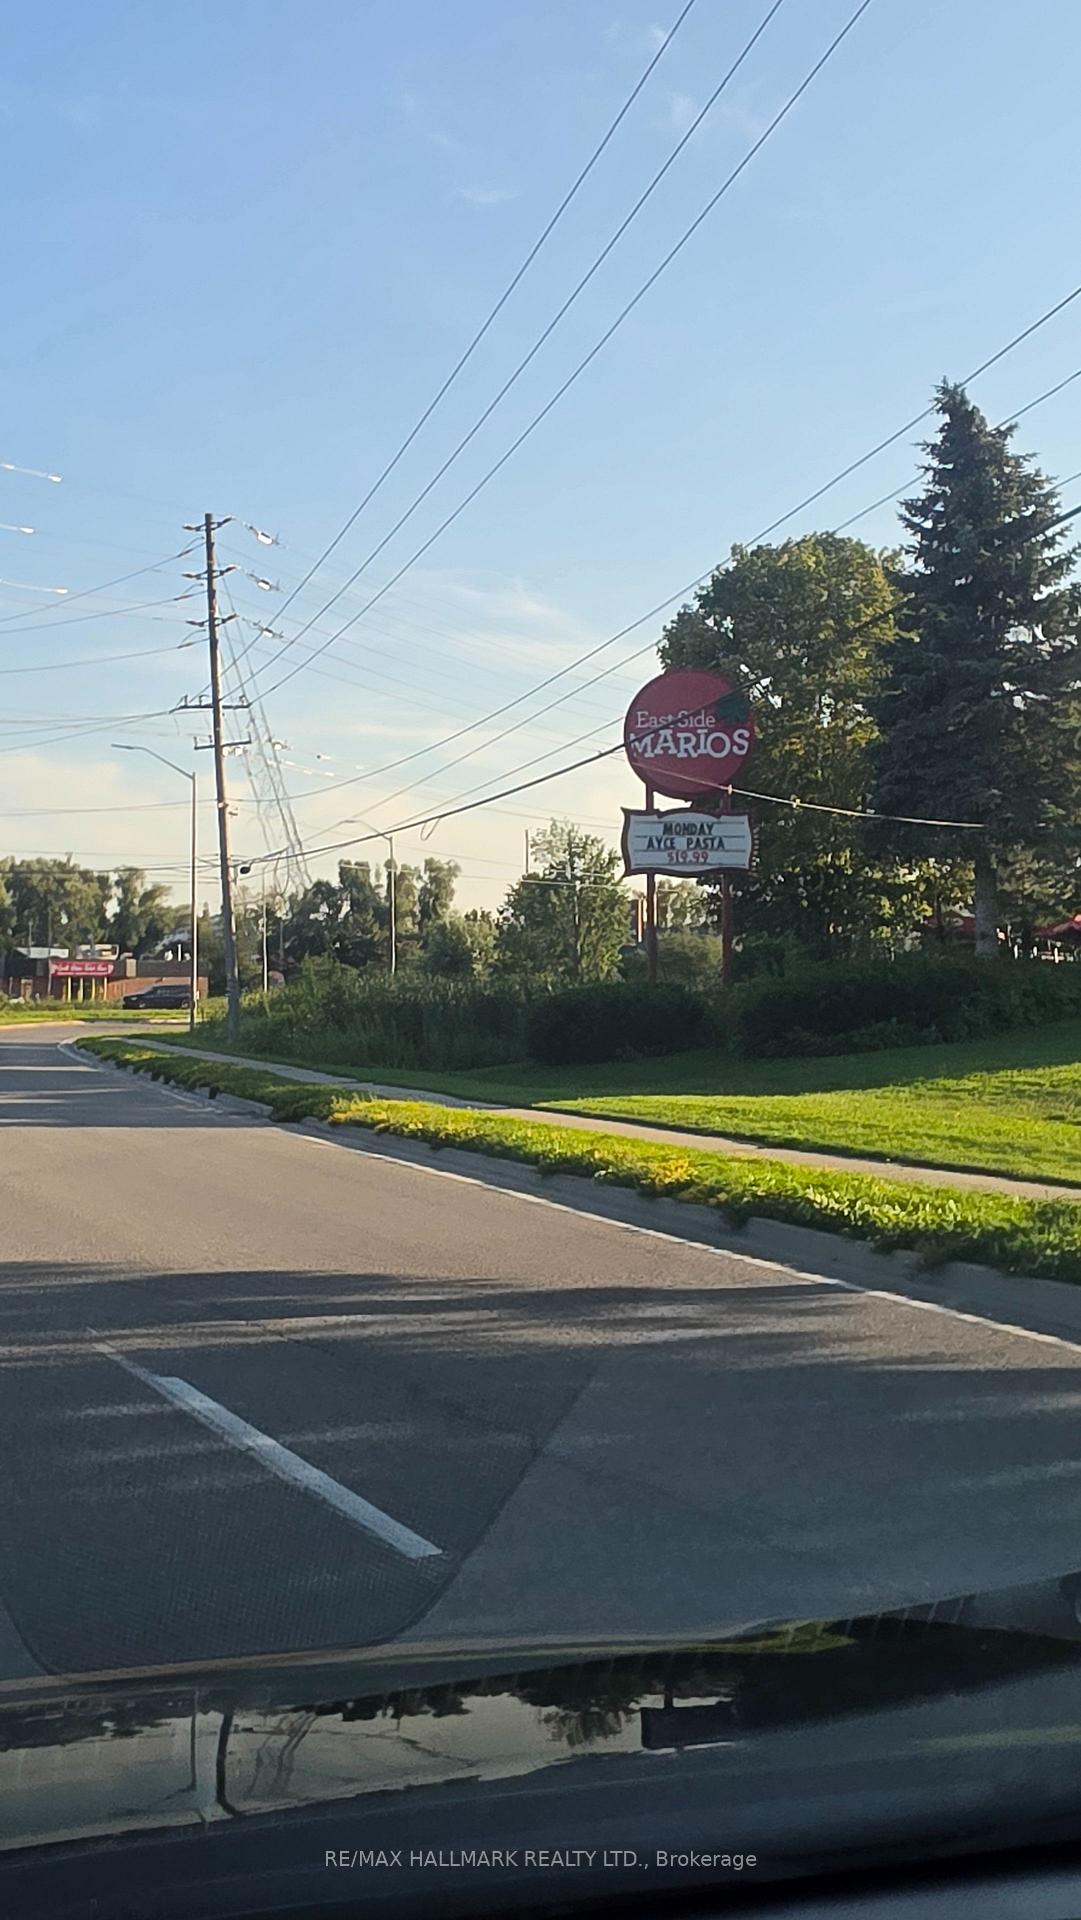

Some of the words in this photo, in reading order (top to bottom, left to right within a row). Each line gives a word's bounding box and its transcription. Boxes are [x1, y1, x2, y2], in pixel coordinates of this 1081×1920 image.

[636, 711, 675, 728] East
[677, 709, 716, 728] Side
[662, 823, 715, 836] MONDAY
[646, 837, 676, 850] AYCE
[686, 837, 726, 850] PASTA
